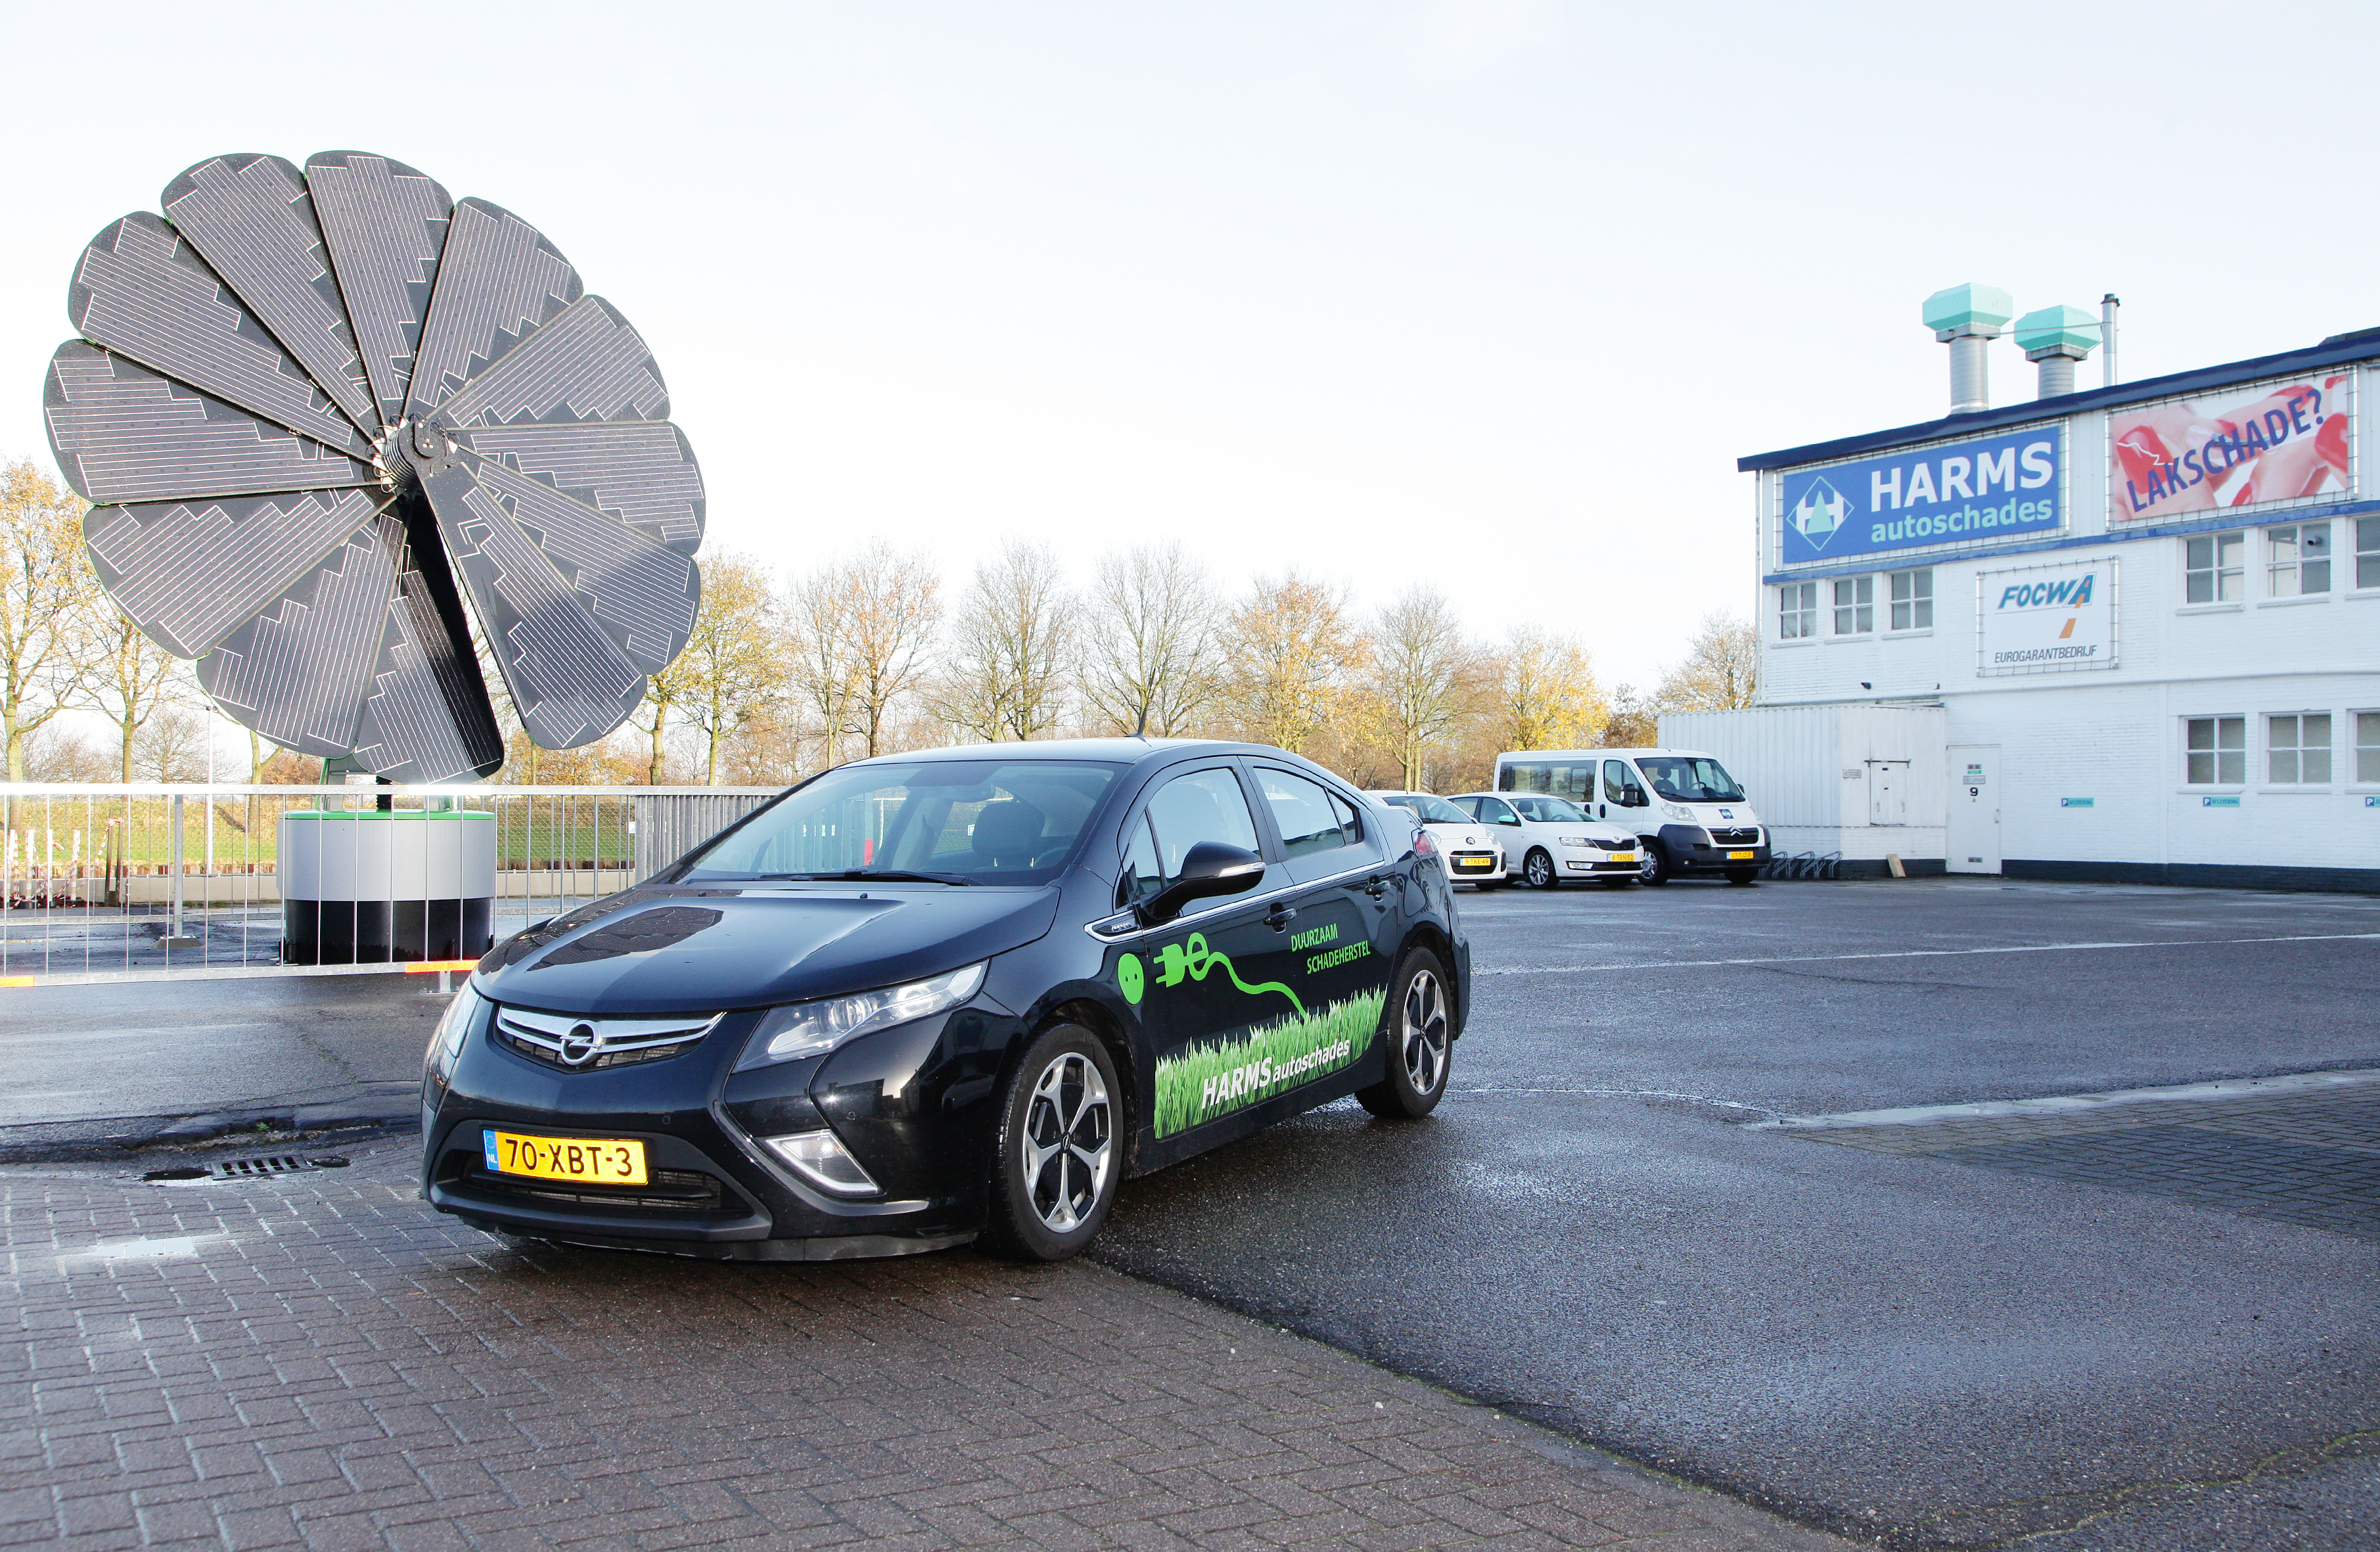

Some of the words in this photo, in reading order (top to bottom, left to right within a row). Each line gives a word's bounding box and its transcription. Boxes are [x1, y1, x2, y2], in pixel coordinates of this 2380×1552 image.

[2126, 388, 2324, 513] LAKSCHADE?
[1871, 441, 2053, 513] HARMS
[1871, 497, 2053, 543] autoschades
[1997, 572, 2095, 610] FOCWA
[1994, 644, 2098, 664] EUROGARANTBEDRIJF
[1969, 787, 1979, 796] 9
[1291, 923, 1339, 952] DUURZAAM
[1306, 940, 1371, 974] SCHADEHERSTEL
[1201, 1057, 1273, 1110] HARMS
[1272, 1038, 1351, 1083] autoschades
[488, 1153, 497, 1164] NL
[505, 1137, 633, 1177] 70-XBT-3
